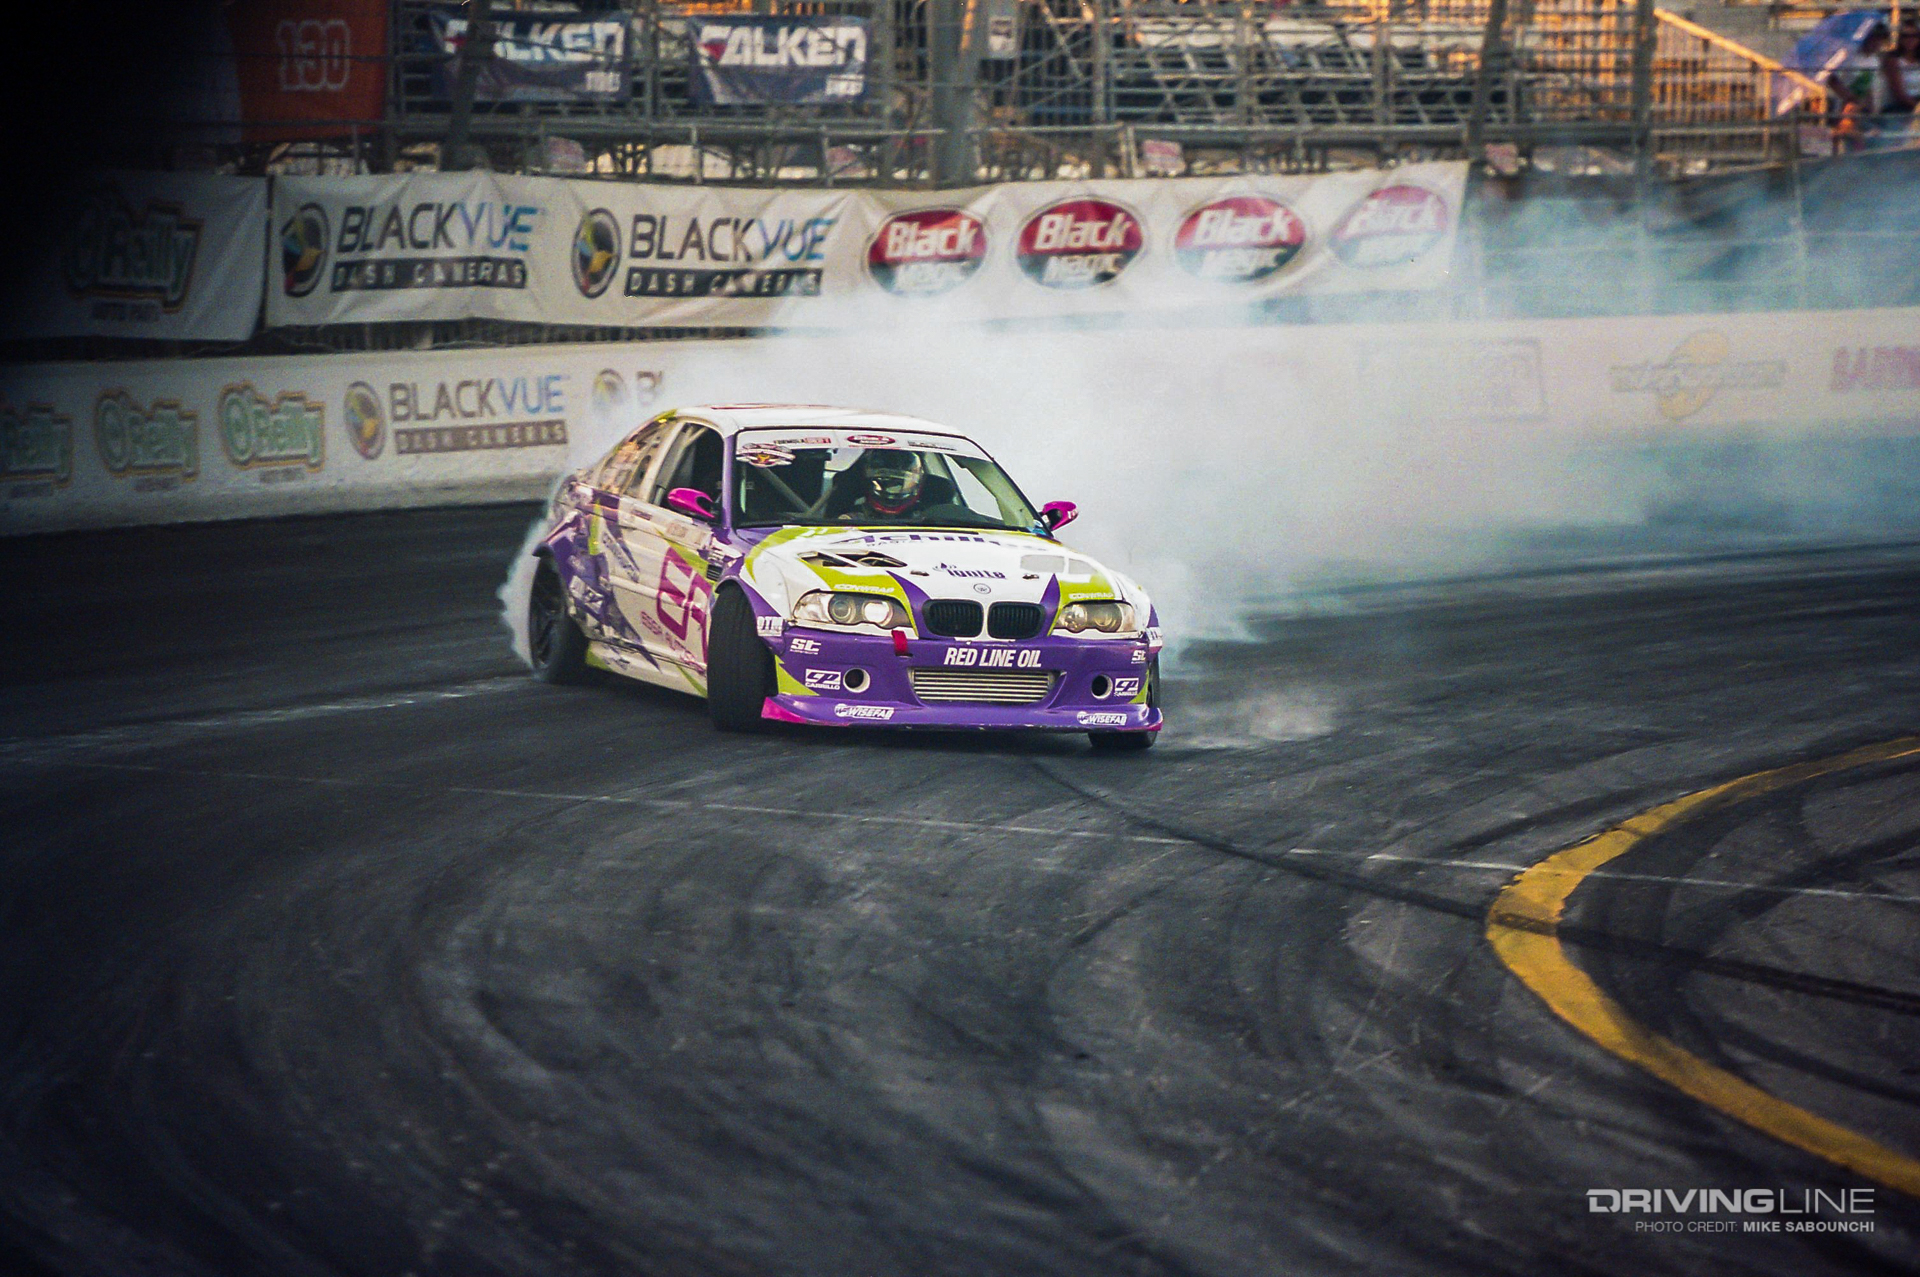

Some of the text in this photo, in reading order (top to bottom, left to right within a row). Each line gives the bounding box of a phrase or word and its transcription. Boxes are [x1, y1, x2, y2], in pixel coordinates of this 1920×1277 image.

[336, 202, 539, 253] BLACKVUE
[628, 213, 836, 262] BLACKVUE
[1033, 212, 1133, 251] Black
[388, 374, 566, 422] BLACKVUE
[943, 647, 1042, 668] RED LINE OIL
